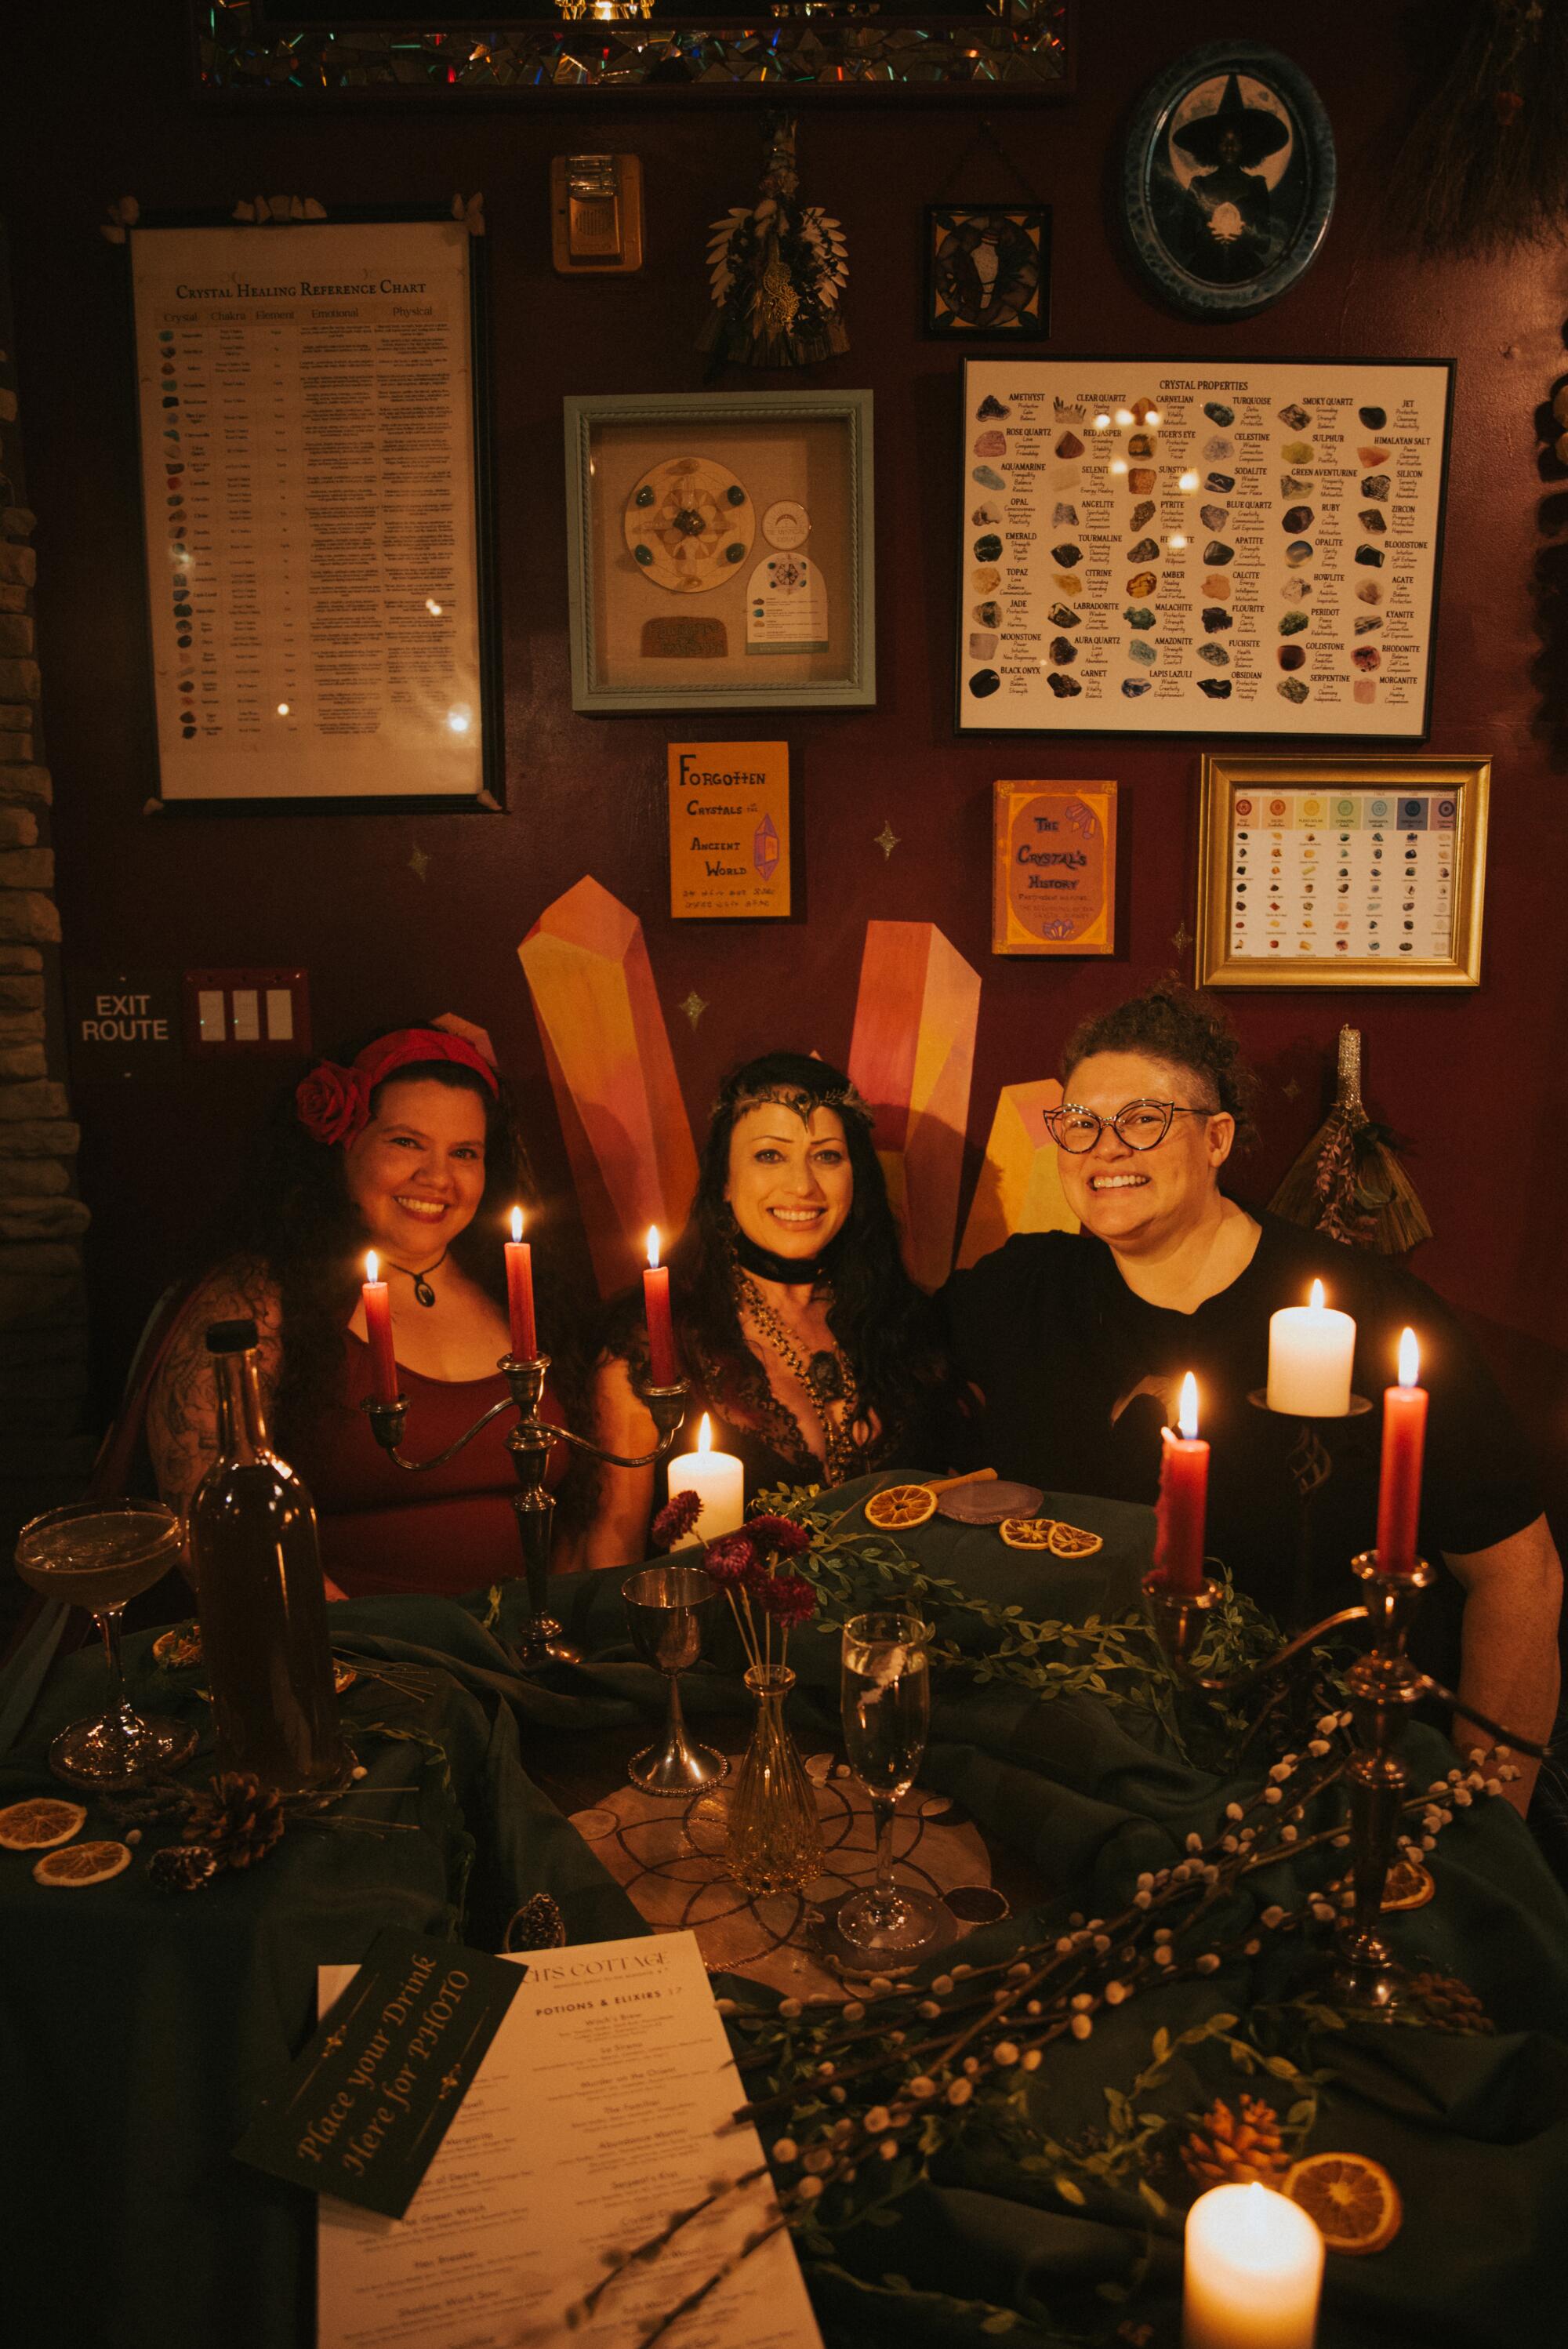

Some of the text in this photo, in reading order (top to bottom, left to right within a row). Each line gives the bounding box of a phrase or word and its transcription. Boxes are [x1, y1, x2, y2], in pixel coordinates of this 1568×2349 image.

[176, 280, 426, 299] CRYSTAL HEALING REFERENCE CHART
[164, 312, 198, 323] Crystal
[211, 310, 246, 321] Chakra
[256, 310, 295, 321] Element
[311, 307, 358, 318] Emotional
[392, 306, 433, 318] Physical
[1160, 380, 1248, 390] CRYSTAL PROPERTIES
[679, 754, 766, 786] FORGOTTEN
[687, 800, 742, 815] CRYSTALS
[1034, 818, 1059, 832] THE
[690, 837, 740, 851] ANCIENT
[705, 861, 746, 876] WORLD
[1029, 875, 1079, 889] HISTORY
[95, 994, 151, 1015] EXIT
[82, 1019, 169, 1041] ROUTE
[571, 1951, 669, 1977] COTTAGE
[536, 2002, 593, 2016] POTIONS
[615, 1991, 661, 2004] ELIXIRS
[296, 1953, 439, 2163] Place your Drink
[341, 1970, 471, 2177] Here for PHOTO
